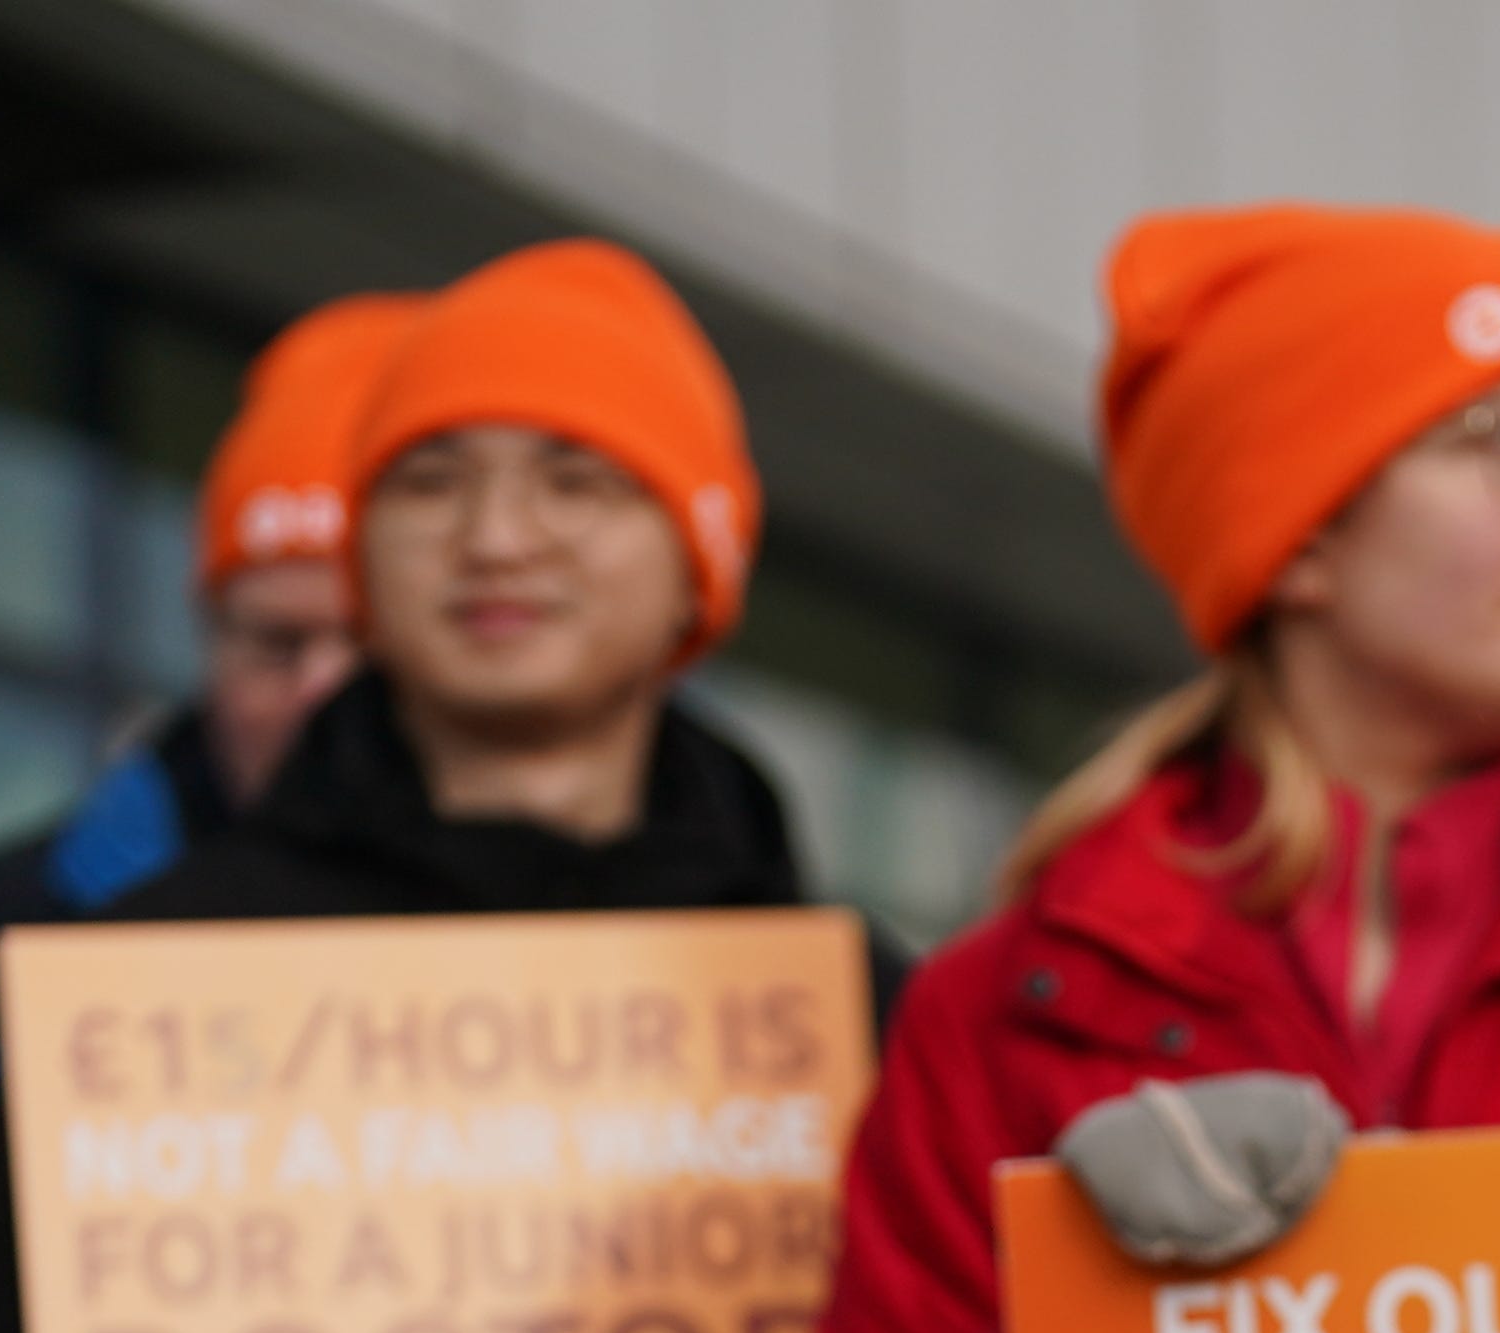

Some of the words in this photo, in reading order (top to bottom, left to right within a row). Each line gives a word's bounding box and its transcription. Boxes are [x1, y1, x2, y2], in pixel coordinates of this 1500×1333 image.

[720, 981, 823, 1084] IS
[62, 1116, 255, 1198] NOT
[274, 1114, 346, 1192] A
[361, 1103, 560, 1187] FAIR
[78, 1207, 297, 1302] FOR
[336, 1211, 407, 1288] A
